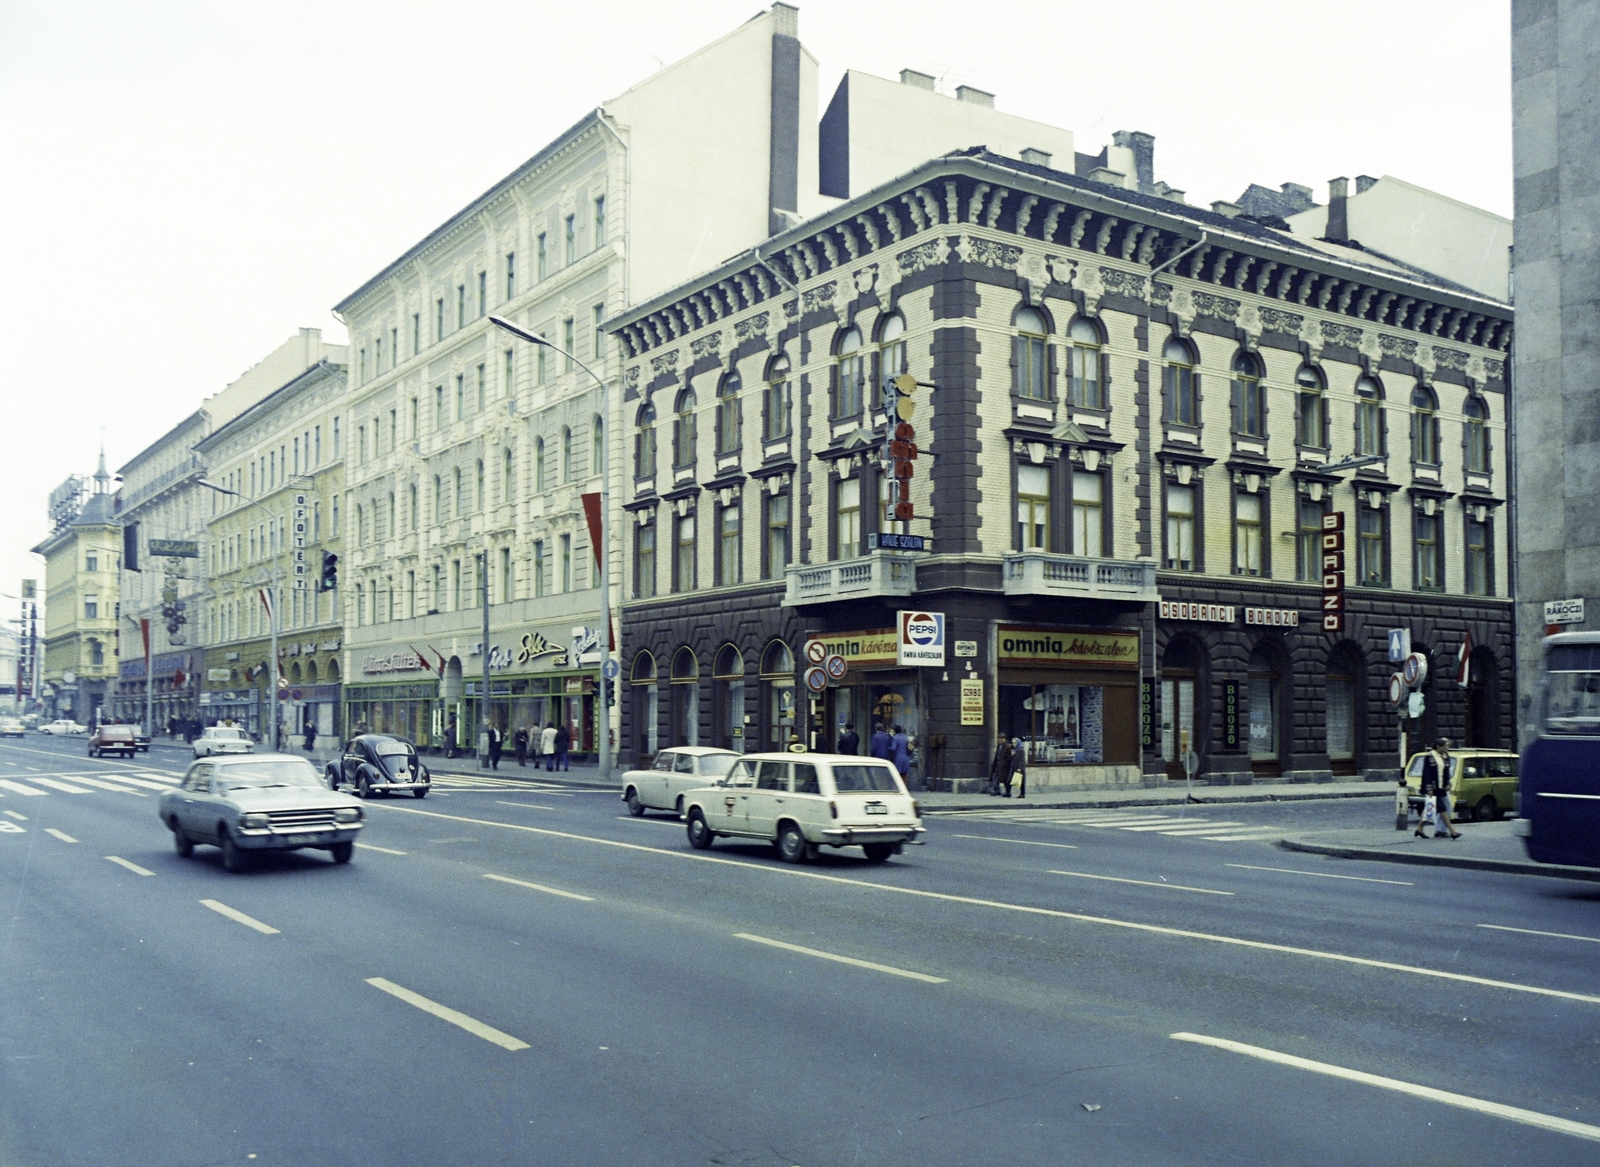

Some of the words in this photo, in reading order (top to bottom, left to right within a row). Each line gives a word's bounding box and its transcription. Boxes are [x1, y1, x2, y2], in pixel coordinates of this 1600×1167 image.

[909, 625, 937, 634] PEPSI
[826, 640, 860, 656] mnia
[860, 639, 898, 655] kávésza
[1003, 636, 1063, 654] omnia
